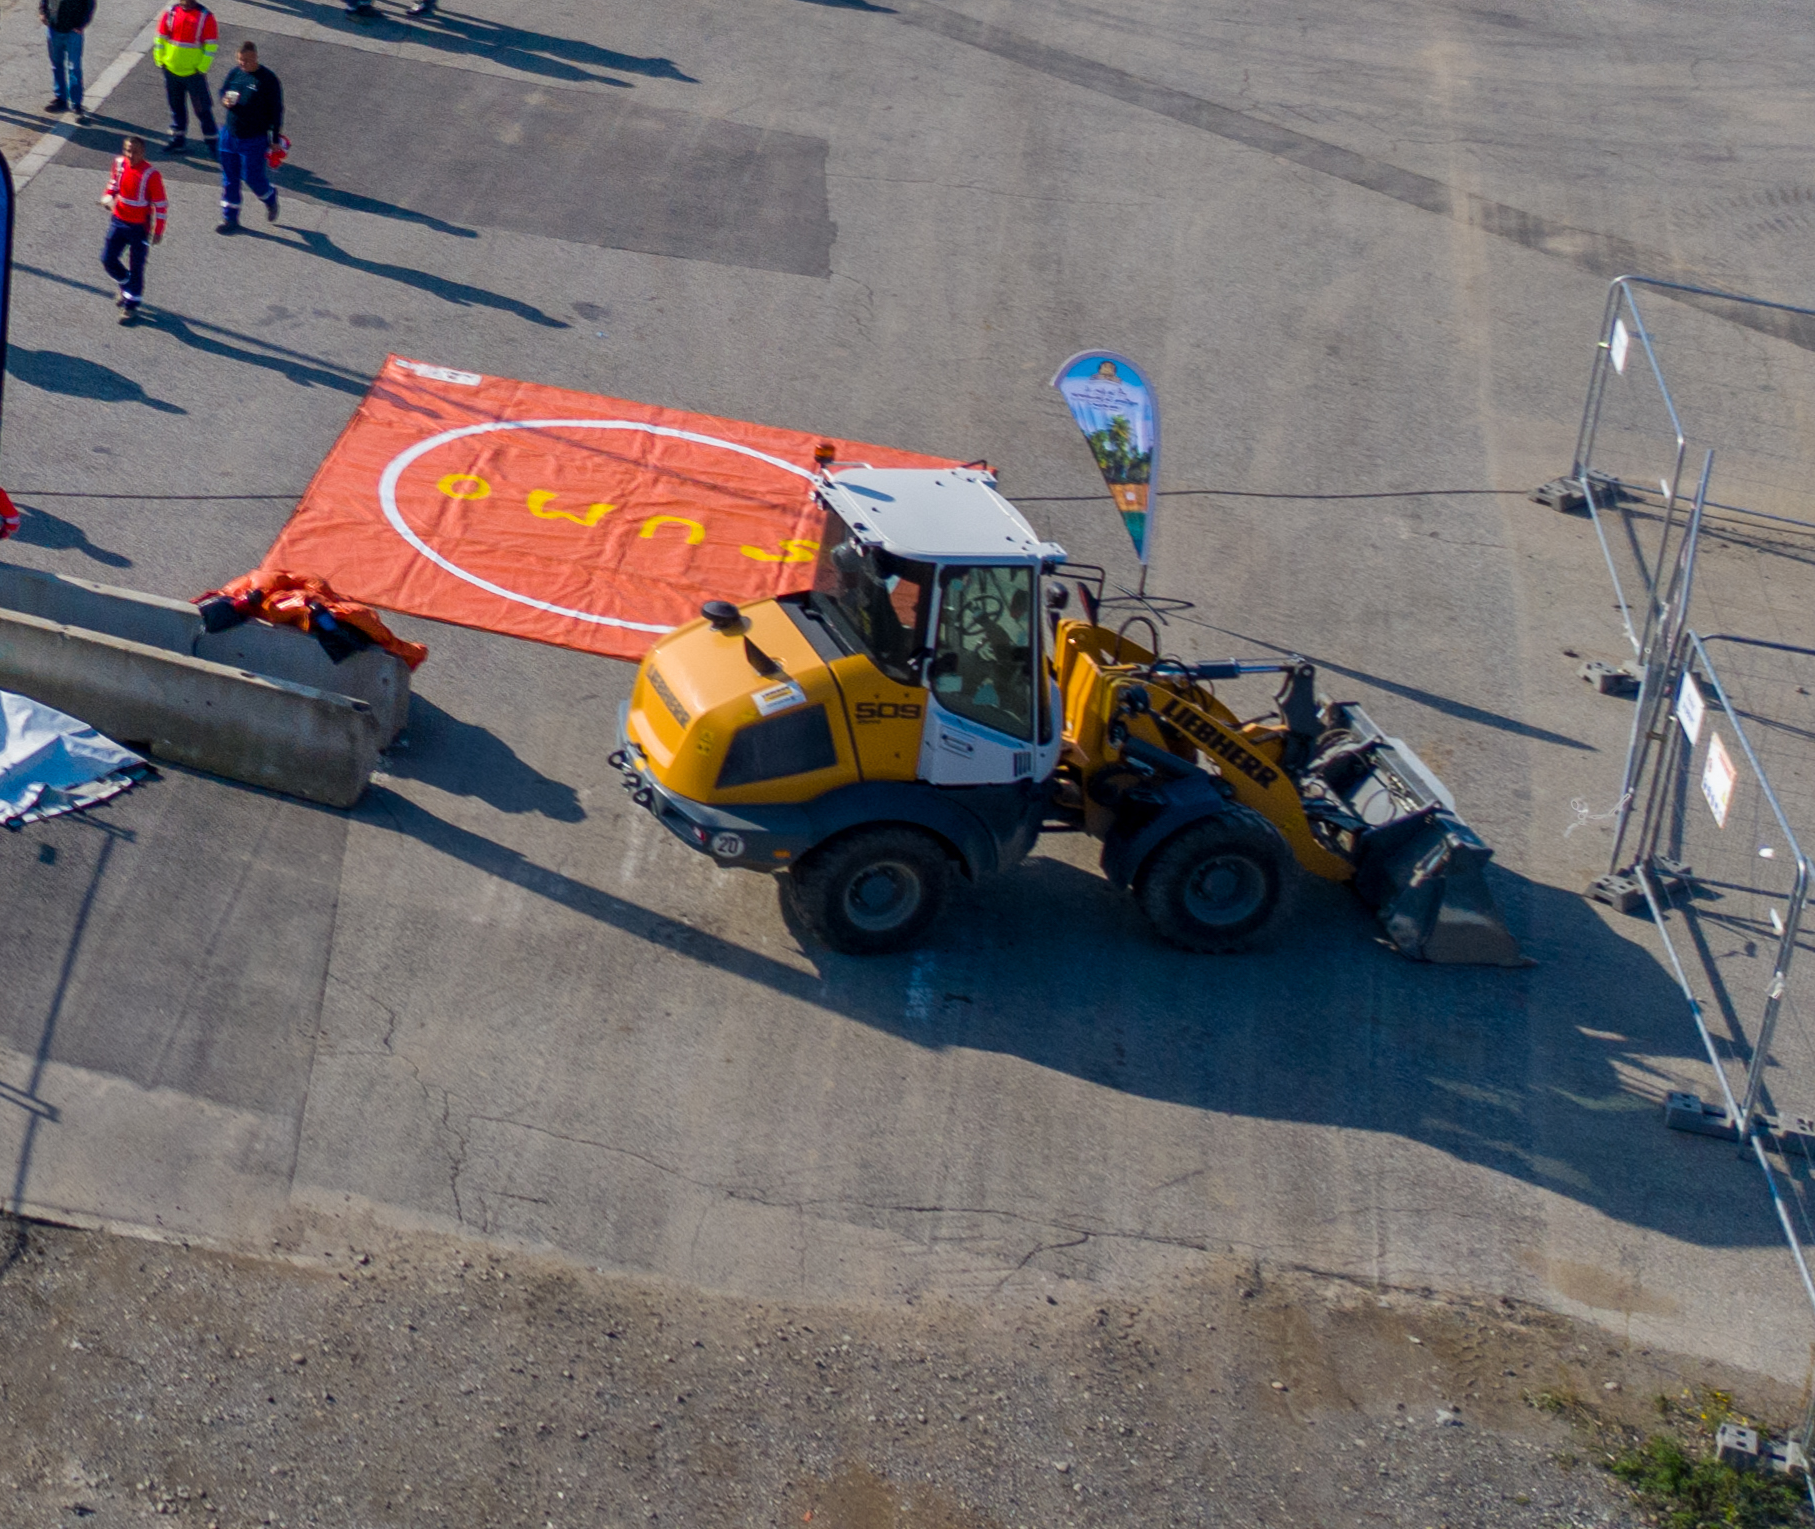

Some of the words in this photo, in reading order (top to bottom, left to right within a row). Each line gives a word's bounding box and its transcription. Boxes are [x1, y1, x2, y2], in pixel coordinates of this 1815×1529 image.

[855, 702, 922, 720] 509
[1161, 699, 1279, 789] LIEBHERR
[718, 836, 739, 854] 20
